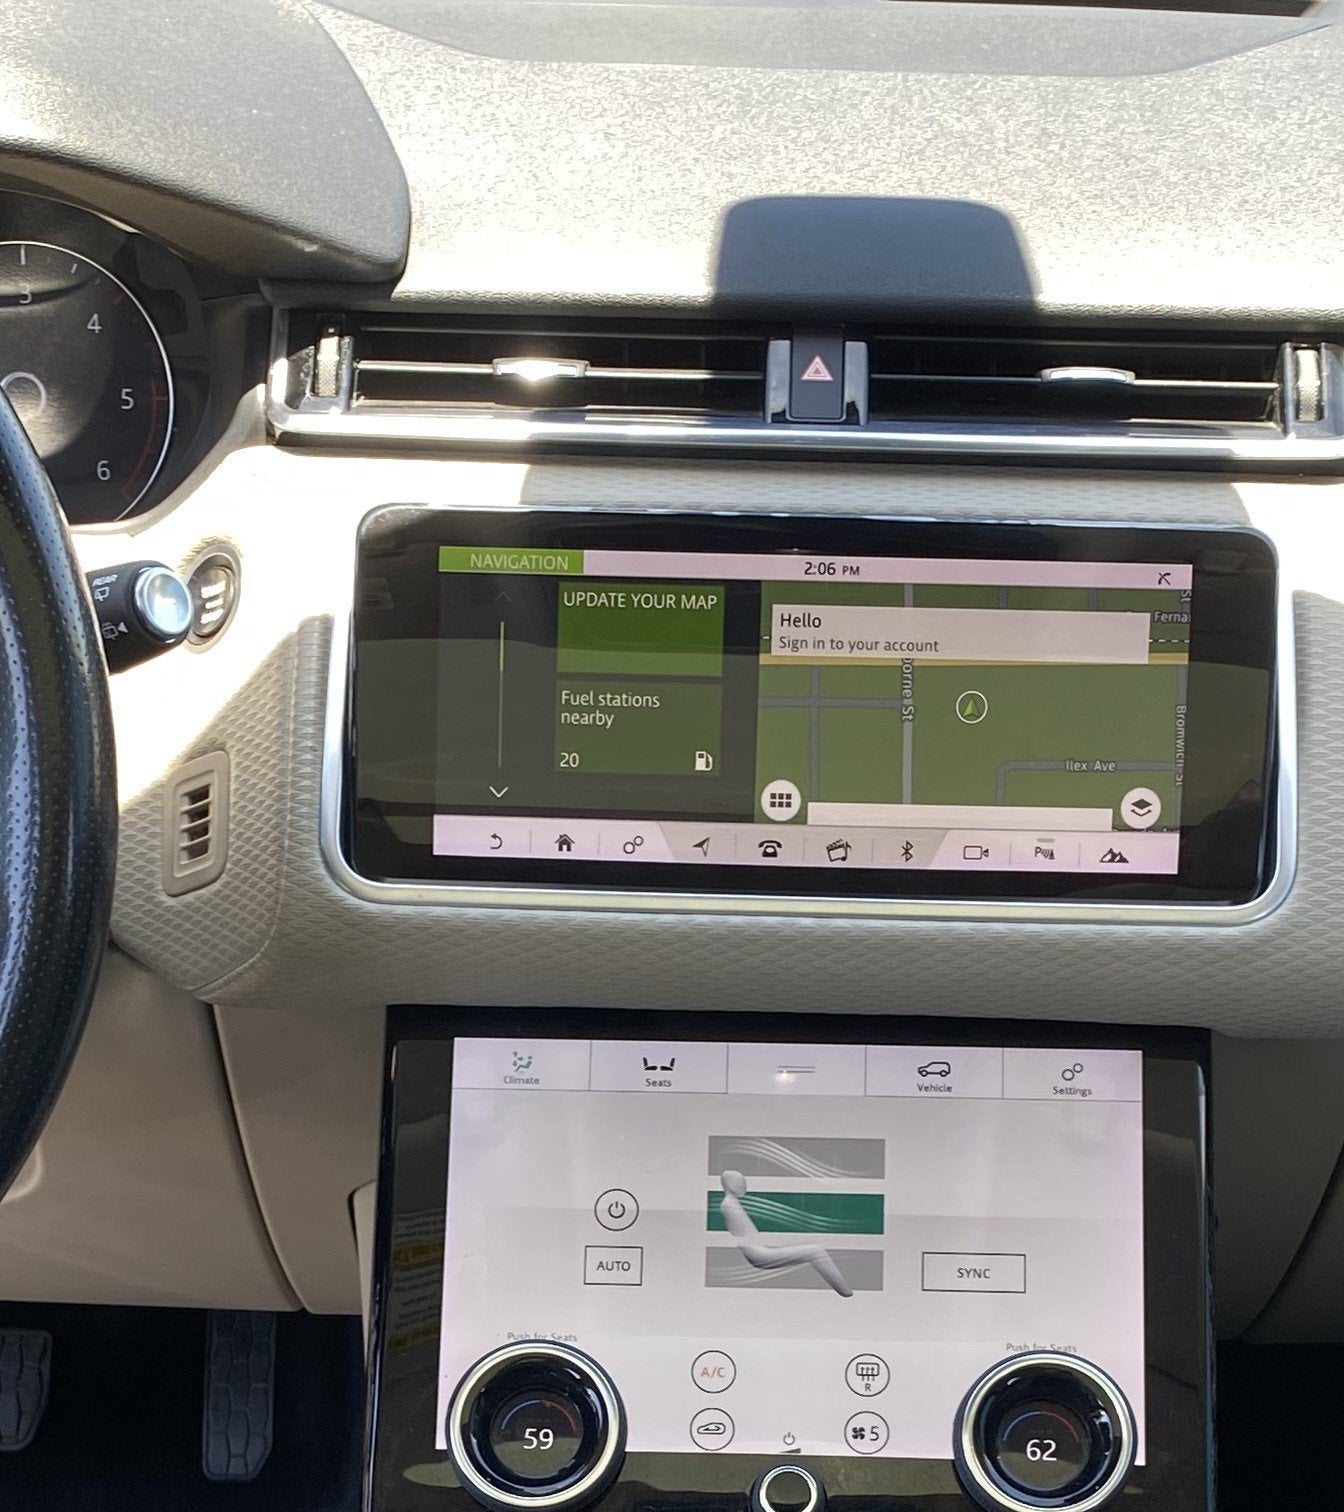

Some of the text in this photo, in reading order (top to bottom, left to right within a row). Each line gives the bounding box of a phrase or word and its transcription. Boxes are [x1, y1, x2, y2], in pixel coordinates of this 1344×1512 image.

[19, 283, 33, 304] 3
[86, 313, 103, 334] 4
[120, 388, 135, 410] 5
[96, 460, 112, 481] 6
[469, 553, 570, 571] NAVIGATION
[804, 561, 861, 577] 2:06 PM
[563, 592, 718, 610] UPDATE YOUR MAP
[780, 612, 822, 629] Hello
[779, 636, 940, 654] Sign in to your account
[561, 690, 660, 708] Fuel stations
[560, 709, 615, 729] nearby
[559, 752, 580, 768] 20
[1093, 760, 1116, 772] Ave
[503, 1075, 541, 1086] Climate
[645, 1077, 673, 1088] Seats
[917, 1083, 953, 1093] Vehicle
[1052, 1085, 1093, 1097] Settings
[596, 1260, 632, 1272] AUTO
[956, 1267, 992, 1280] SYNC
[507, 1331, 531, 1342] Push
[551, 1332, 578, 1343] Seats
[1005, 1342, 1030, 1352] Push
[1050, 1343, 1078, 1354] Seats
[700, 1365, 726, 1380] A/C
[522, 1427, 555, 1451] 59
[869, 1425, 880, 1442] 5
[1025, 1438, 1058, 1462] 62
